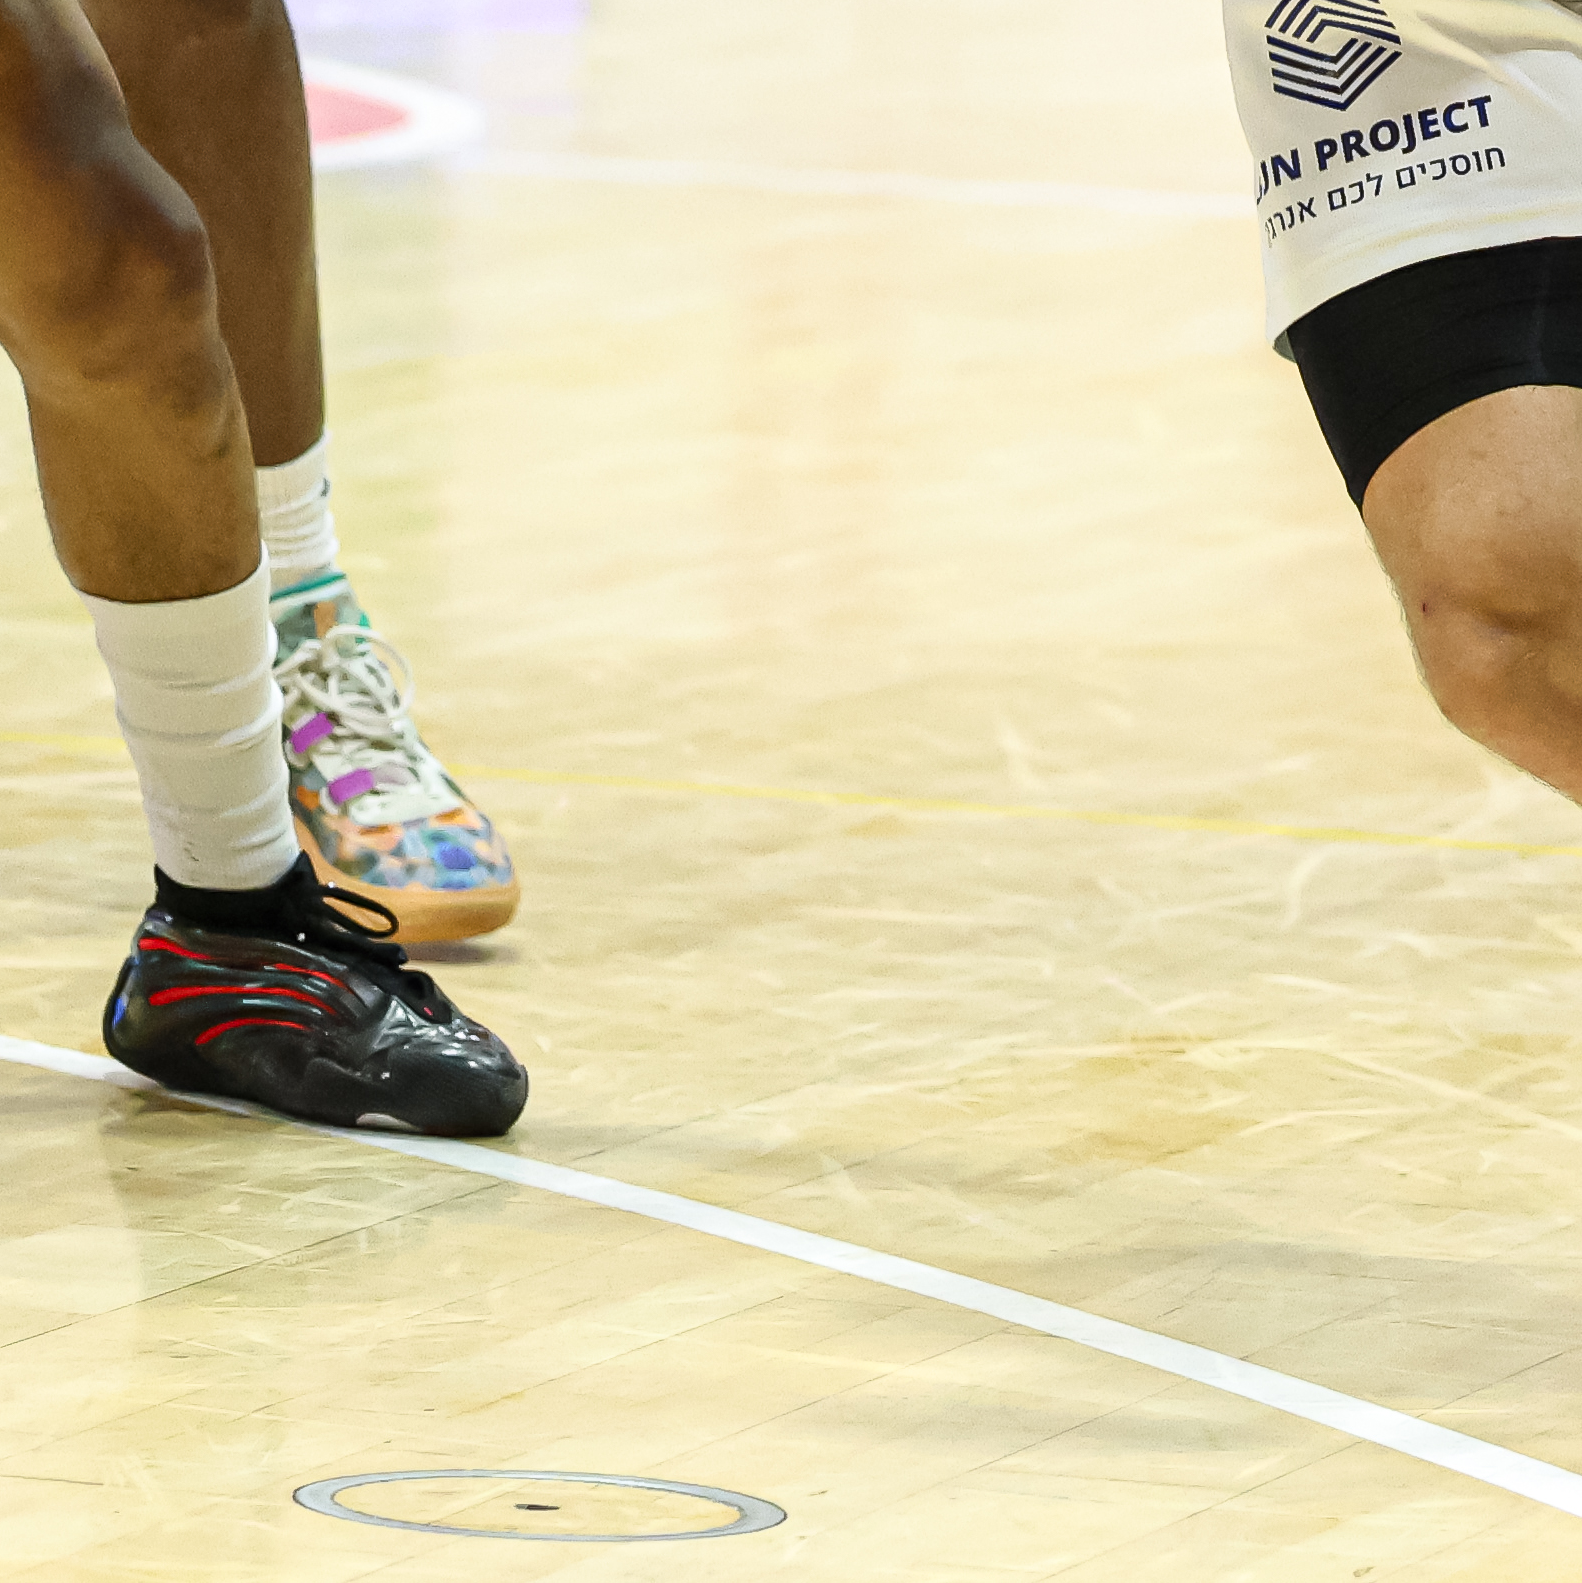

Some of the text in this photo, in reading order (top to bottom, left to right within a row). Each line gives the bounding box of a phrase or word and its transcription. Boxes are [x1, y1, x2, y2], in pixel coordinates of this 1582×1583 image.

[1314, 95, 1492, 172] PROJECT
[1396, 147, 1506, 190] חוסכים
[1327, 172, 1383, 211] לכם
